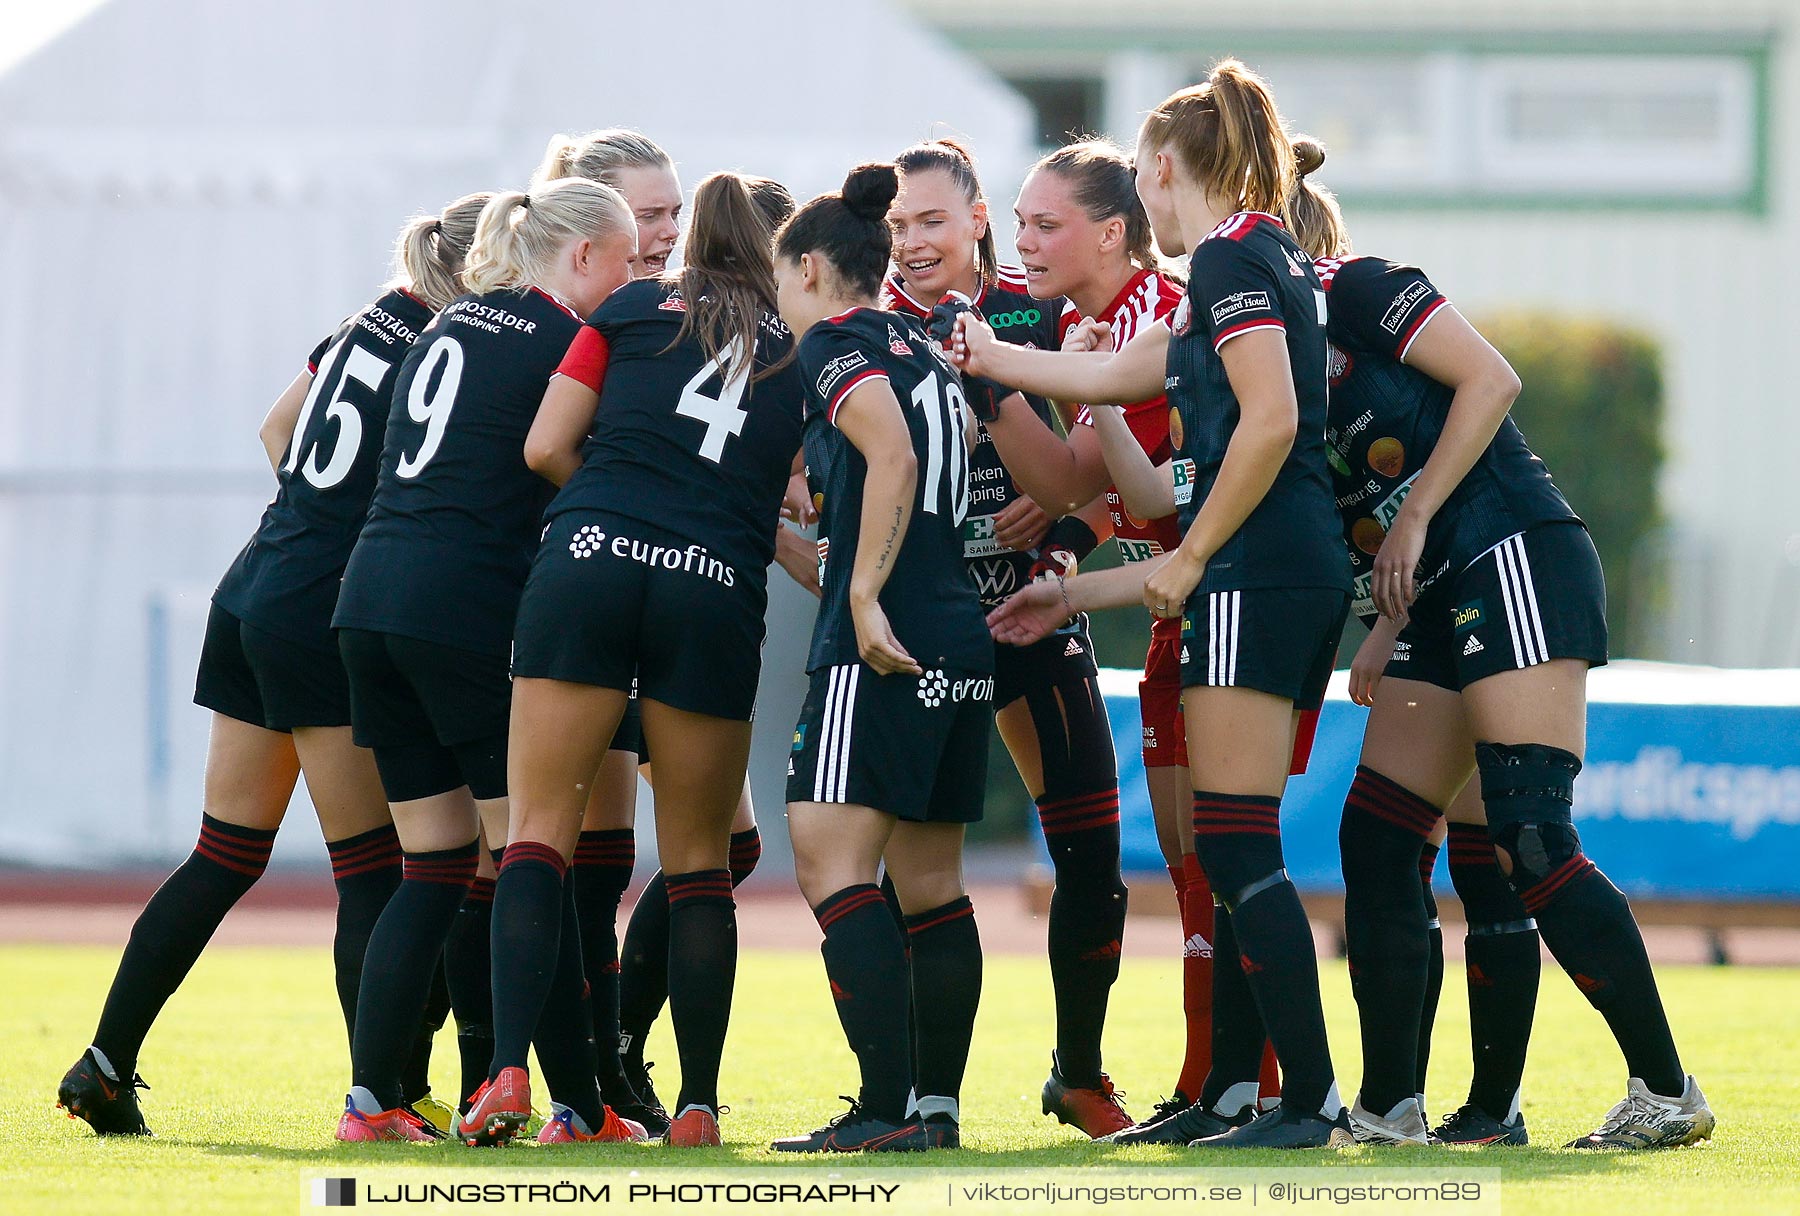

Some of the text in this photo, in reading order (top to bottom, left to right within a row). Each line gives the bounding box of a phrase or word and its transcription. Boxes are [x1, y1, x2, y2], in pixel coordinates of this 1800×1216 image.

[450, 313, 502, 334] LIDKÖPING
[458, 300, 537, 334] BOSTÄDER
[988, 308, 1042, 329] coop
[1215, 296, 1267, 319] Edward Hotel
[1387, 284, 1427, 329] Edward Hotel
[820, 356, 863, 393] Edward Hotel
[281, 337, 393, 490] 15
[395, 336, 464, 479] 9
[675, 331, 757, 464] 4
[911, 370, 970, 528] 10
[969, 467, 1004, 483] nken
[611, 535, 735, 588] eurofins
